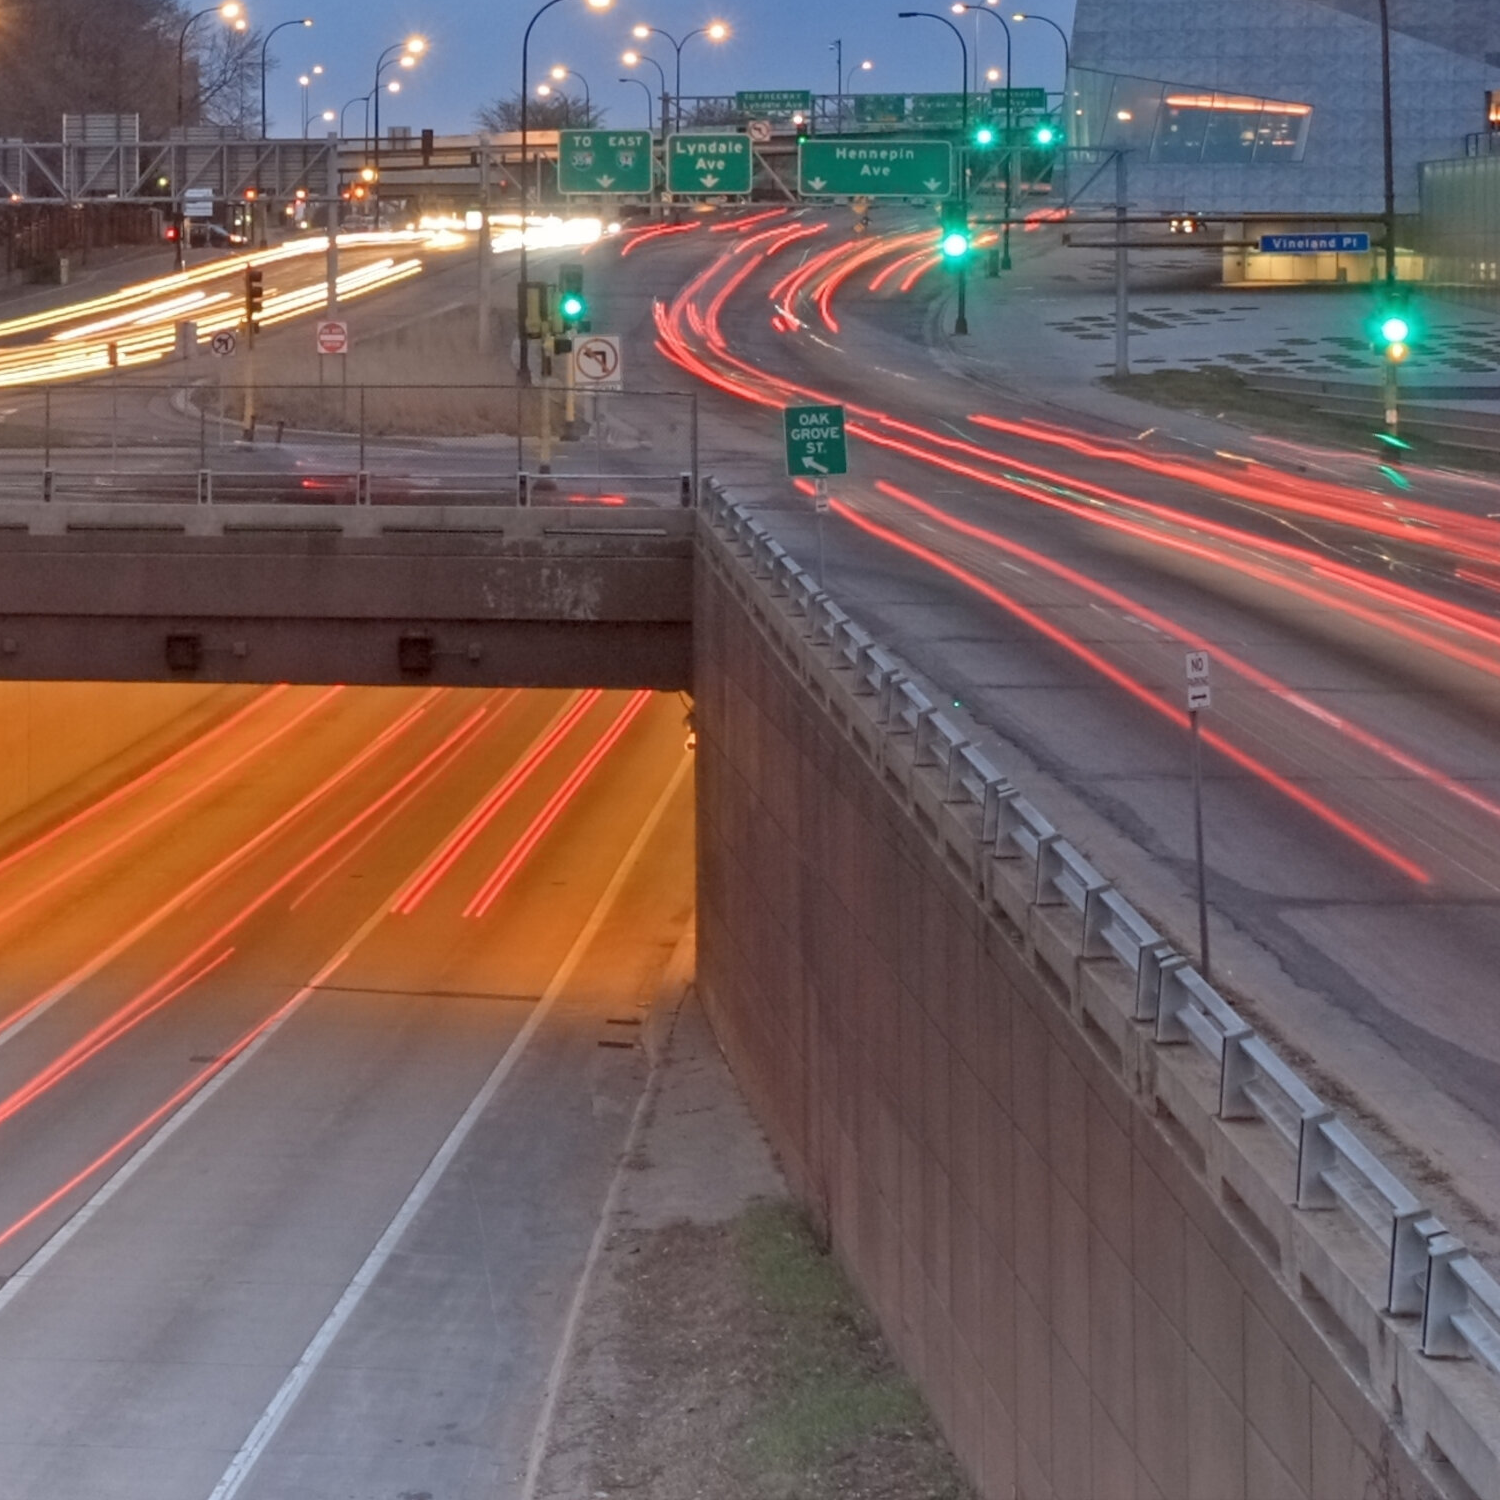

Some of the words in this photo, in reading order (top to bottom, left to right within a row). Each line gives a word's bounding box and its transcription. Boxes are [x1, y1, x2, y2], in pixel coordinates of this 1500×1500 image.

[573, 136, 592, 147] TO
[608, 136, 643, 147] EAST
[676, 141, 743, 156] Lyndale
[836, 148, 915, 161] Hennepin
[695, 158, 726, 170] Ave
[860, 164, 891, 176] Ave
[1272, 238, 1336, 249] Vineland
[1342, 237, 1357, 248] Pl
[799, 413, 830, 426] OAK
[791, 427, 840, 440] GROVE
[806, 442, 827, 454] ST.
[1191, 658, 1204, 673] NO
